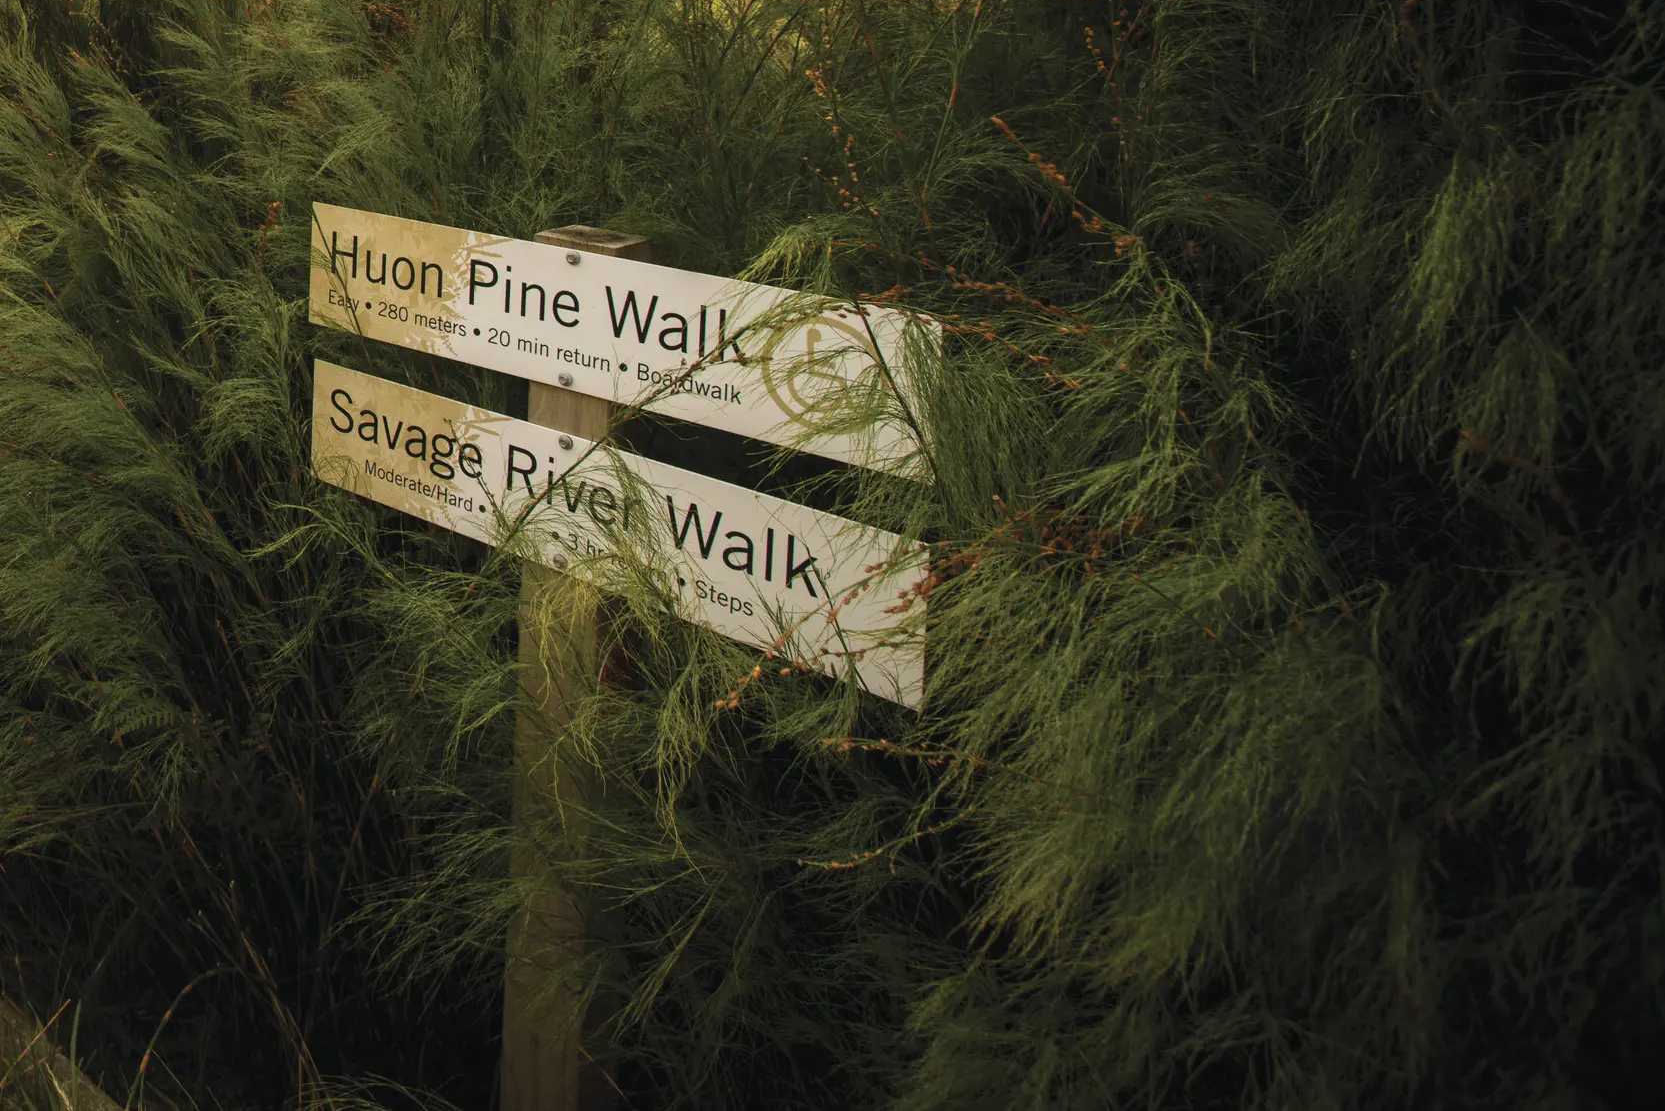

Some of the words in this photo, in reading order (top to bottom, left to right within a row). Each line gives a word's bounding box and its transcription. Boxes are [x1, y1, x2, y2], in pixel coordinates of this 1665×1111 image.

[328, 289, 359, 315] Easy
[378, 301, 408, 322] 280
[414, 313, 467, 337] meters
[487, 328, 510, 347] 20
[517, 338, 549, 357] min
[556, 348, 610, 372] return
[331, 231, 443, 298] Huon
[469, 259, 580, 328] Pine
[605, 285, 746, 363] Walk
[330, 389, 482, 480] Savage
[666, 495, 818, 598] Walk
[365, 459, 473, 513] Moderate/Hard
[568, 533, 578, 551] 3
[695, 579, 754, 617] Steps
